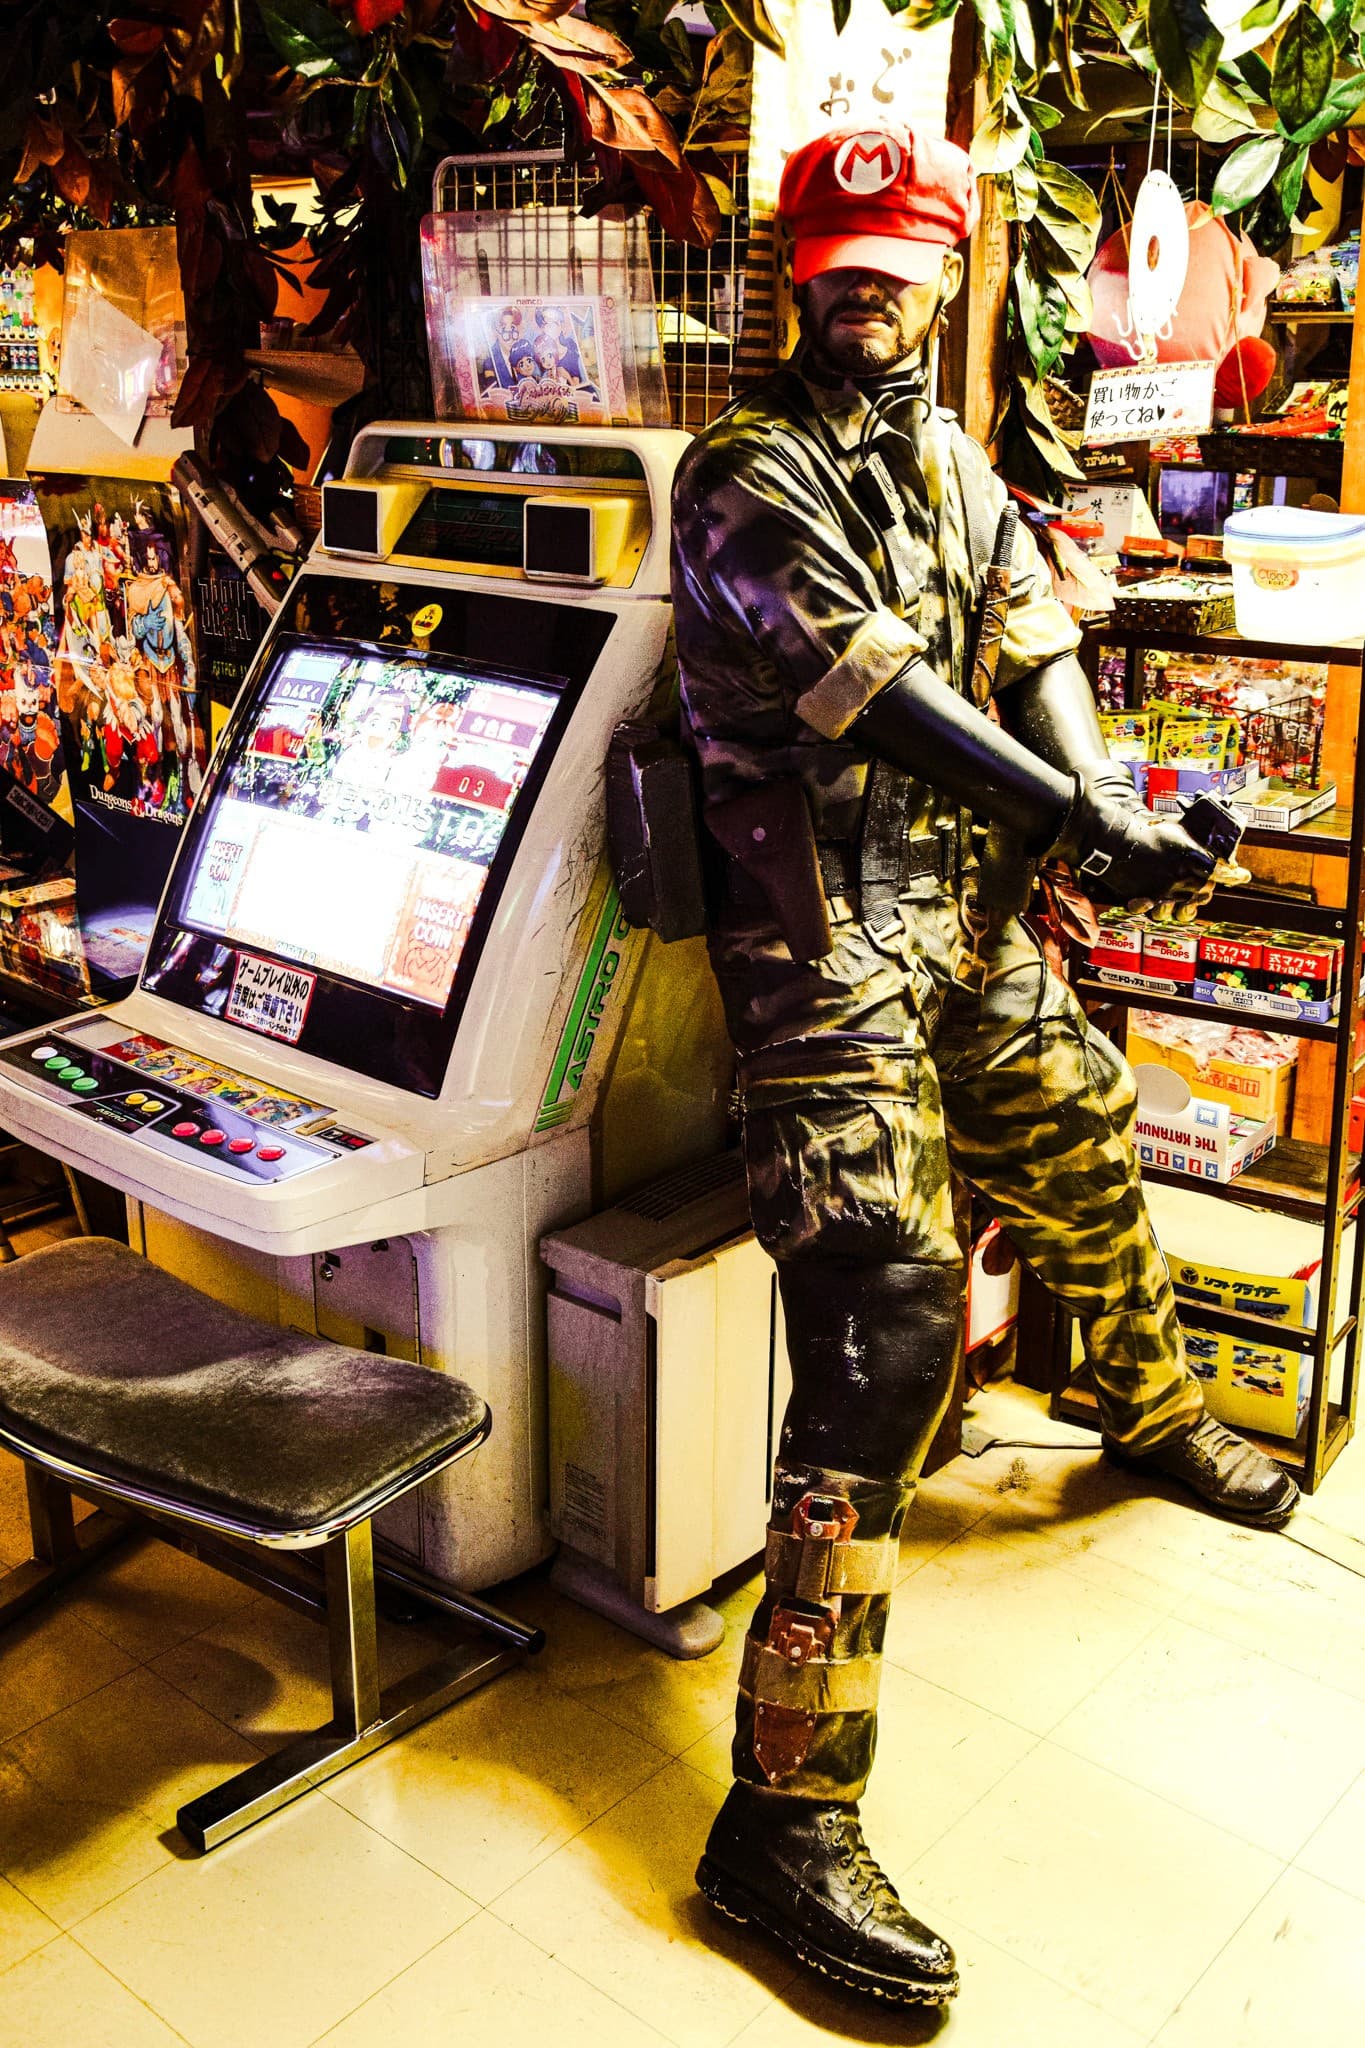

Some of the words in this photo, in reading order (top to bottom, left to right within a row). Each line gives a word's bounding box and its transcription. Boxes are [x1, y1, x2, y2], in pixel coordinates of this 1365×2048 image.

[840, 142, 895, 183] M
[516, 298, 543, 306] namco
[1093, 377, 1178, 405] 買い物かご
[89, 784, 133, 810] Dungeons
[144, 801, 184, 827] Dragons
[210, 840, 244, 864] INSERT
[207, 862, 232, 882] COIN
[414, 900, 467, 932] INSERT
[412, 922, 451, 950] COIN
[1105, 937, 1135, 950] DROPS
[1160, 947, 1190, 960] DROPS
[239, 958, 310, 1000] ゲームプレイ以外の
[566, 950, 621, 1092] ASTRO
[1135, 1120, 1191, 1146] KATANUK
[1195, 1135, 1218, 1153] THE
